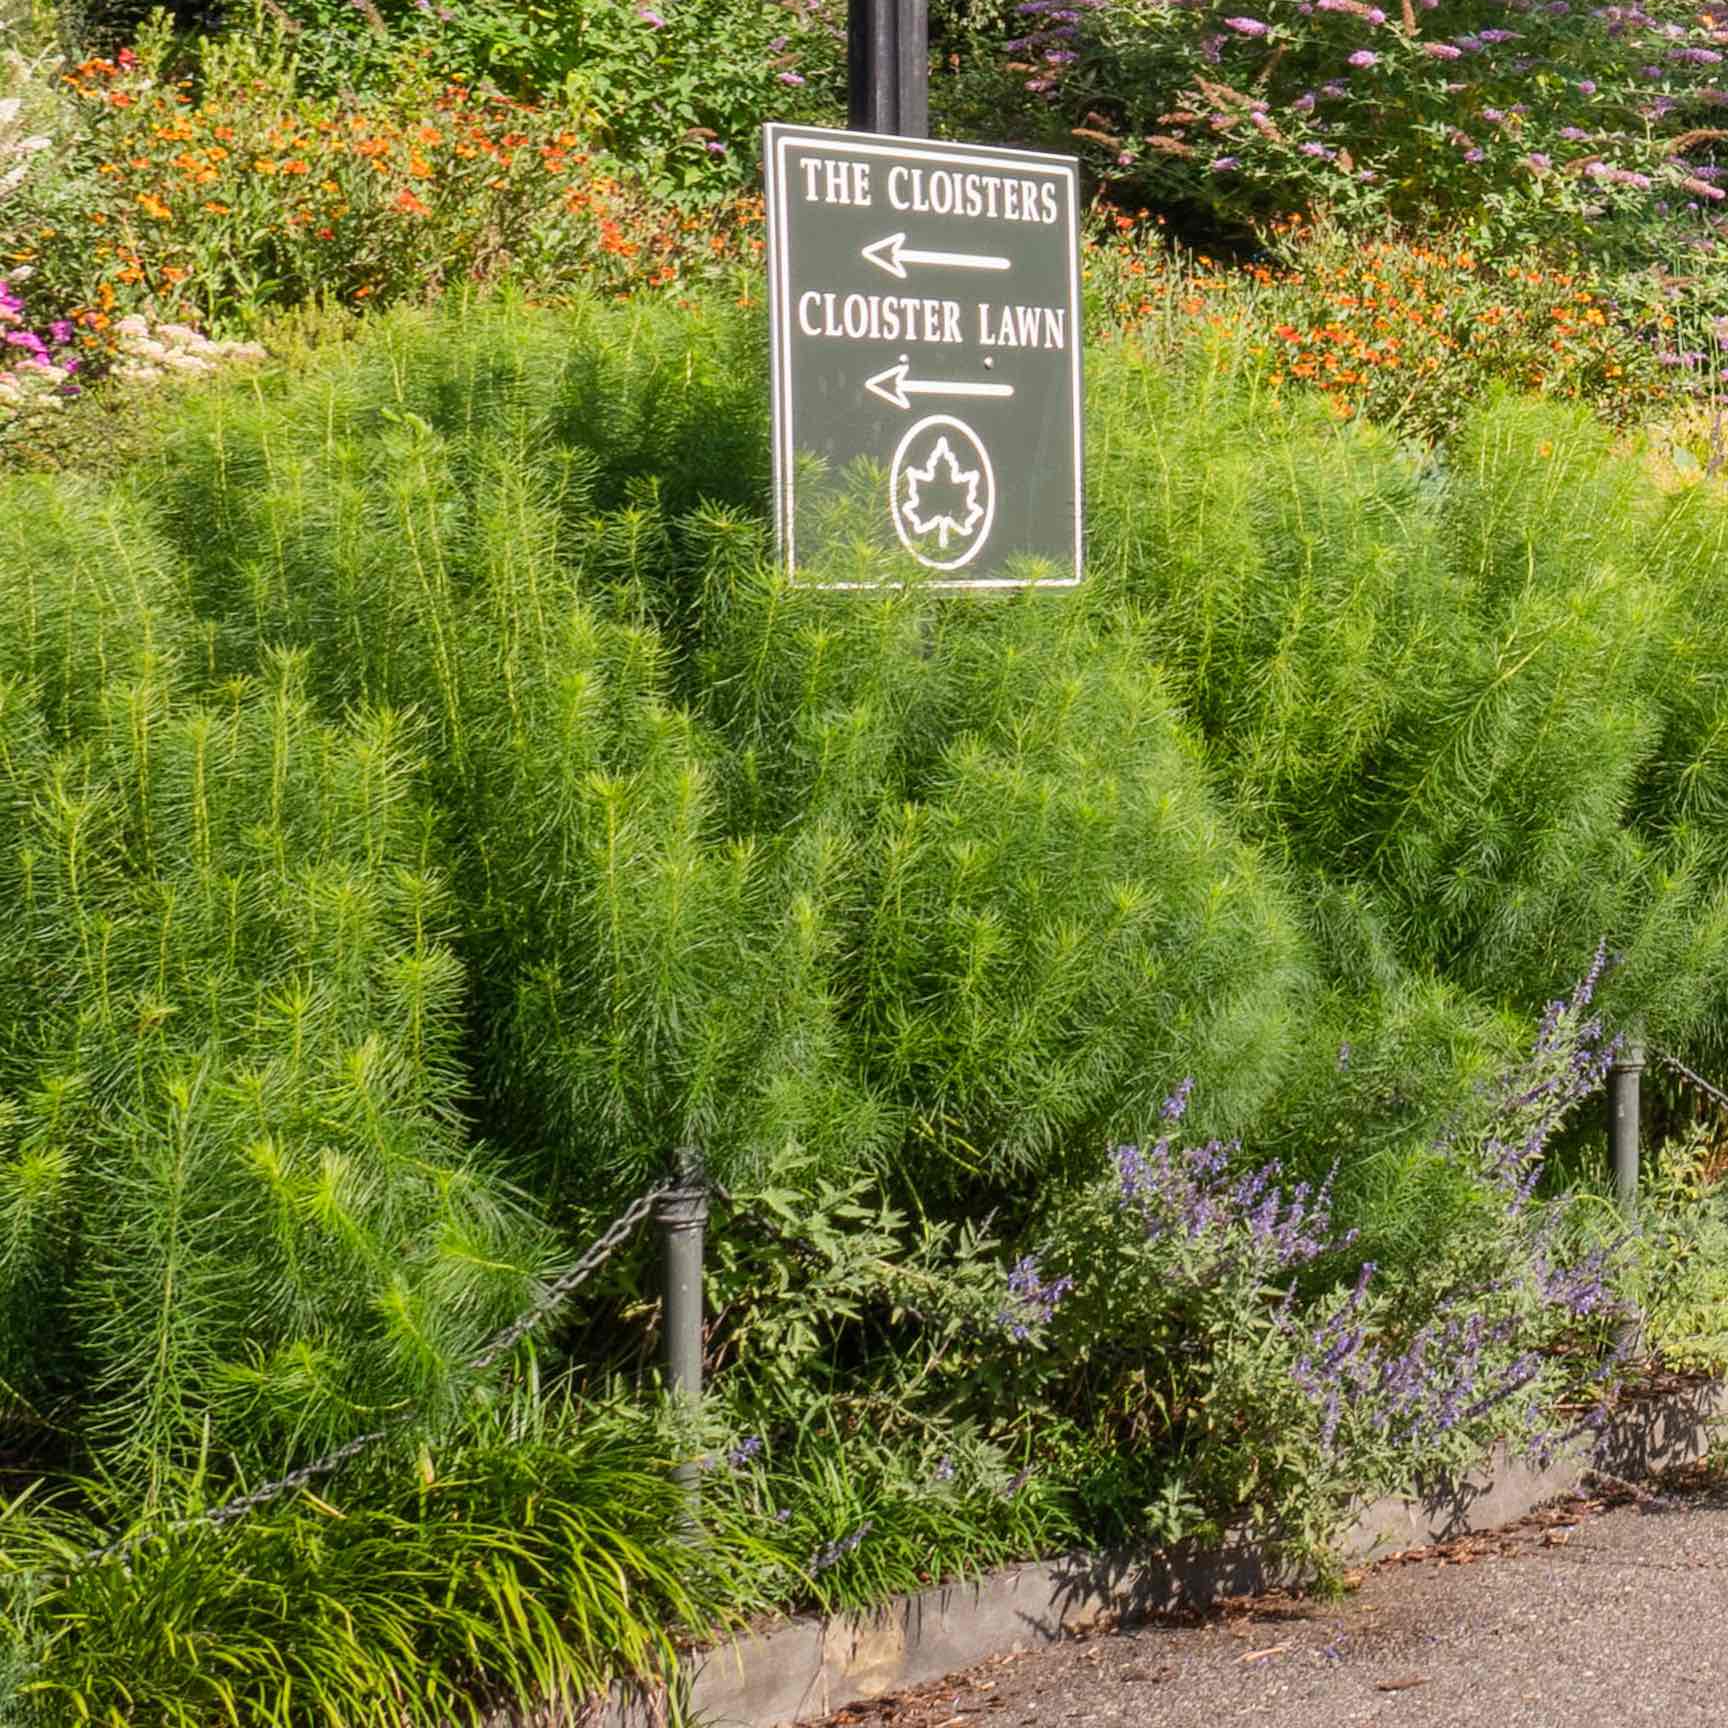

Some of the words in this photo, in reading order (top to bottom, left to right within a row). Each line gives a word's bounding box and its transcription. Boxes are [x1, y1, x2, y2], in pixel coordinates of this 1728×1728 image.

[800, 157, 871, 206] THE
[888, 166, 1057, 224] CLOISTERS
[798, 291, 962, 344] CLOISTER
[979, 304, 1065, 349] LAWN
